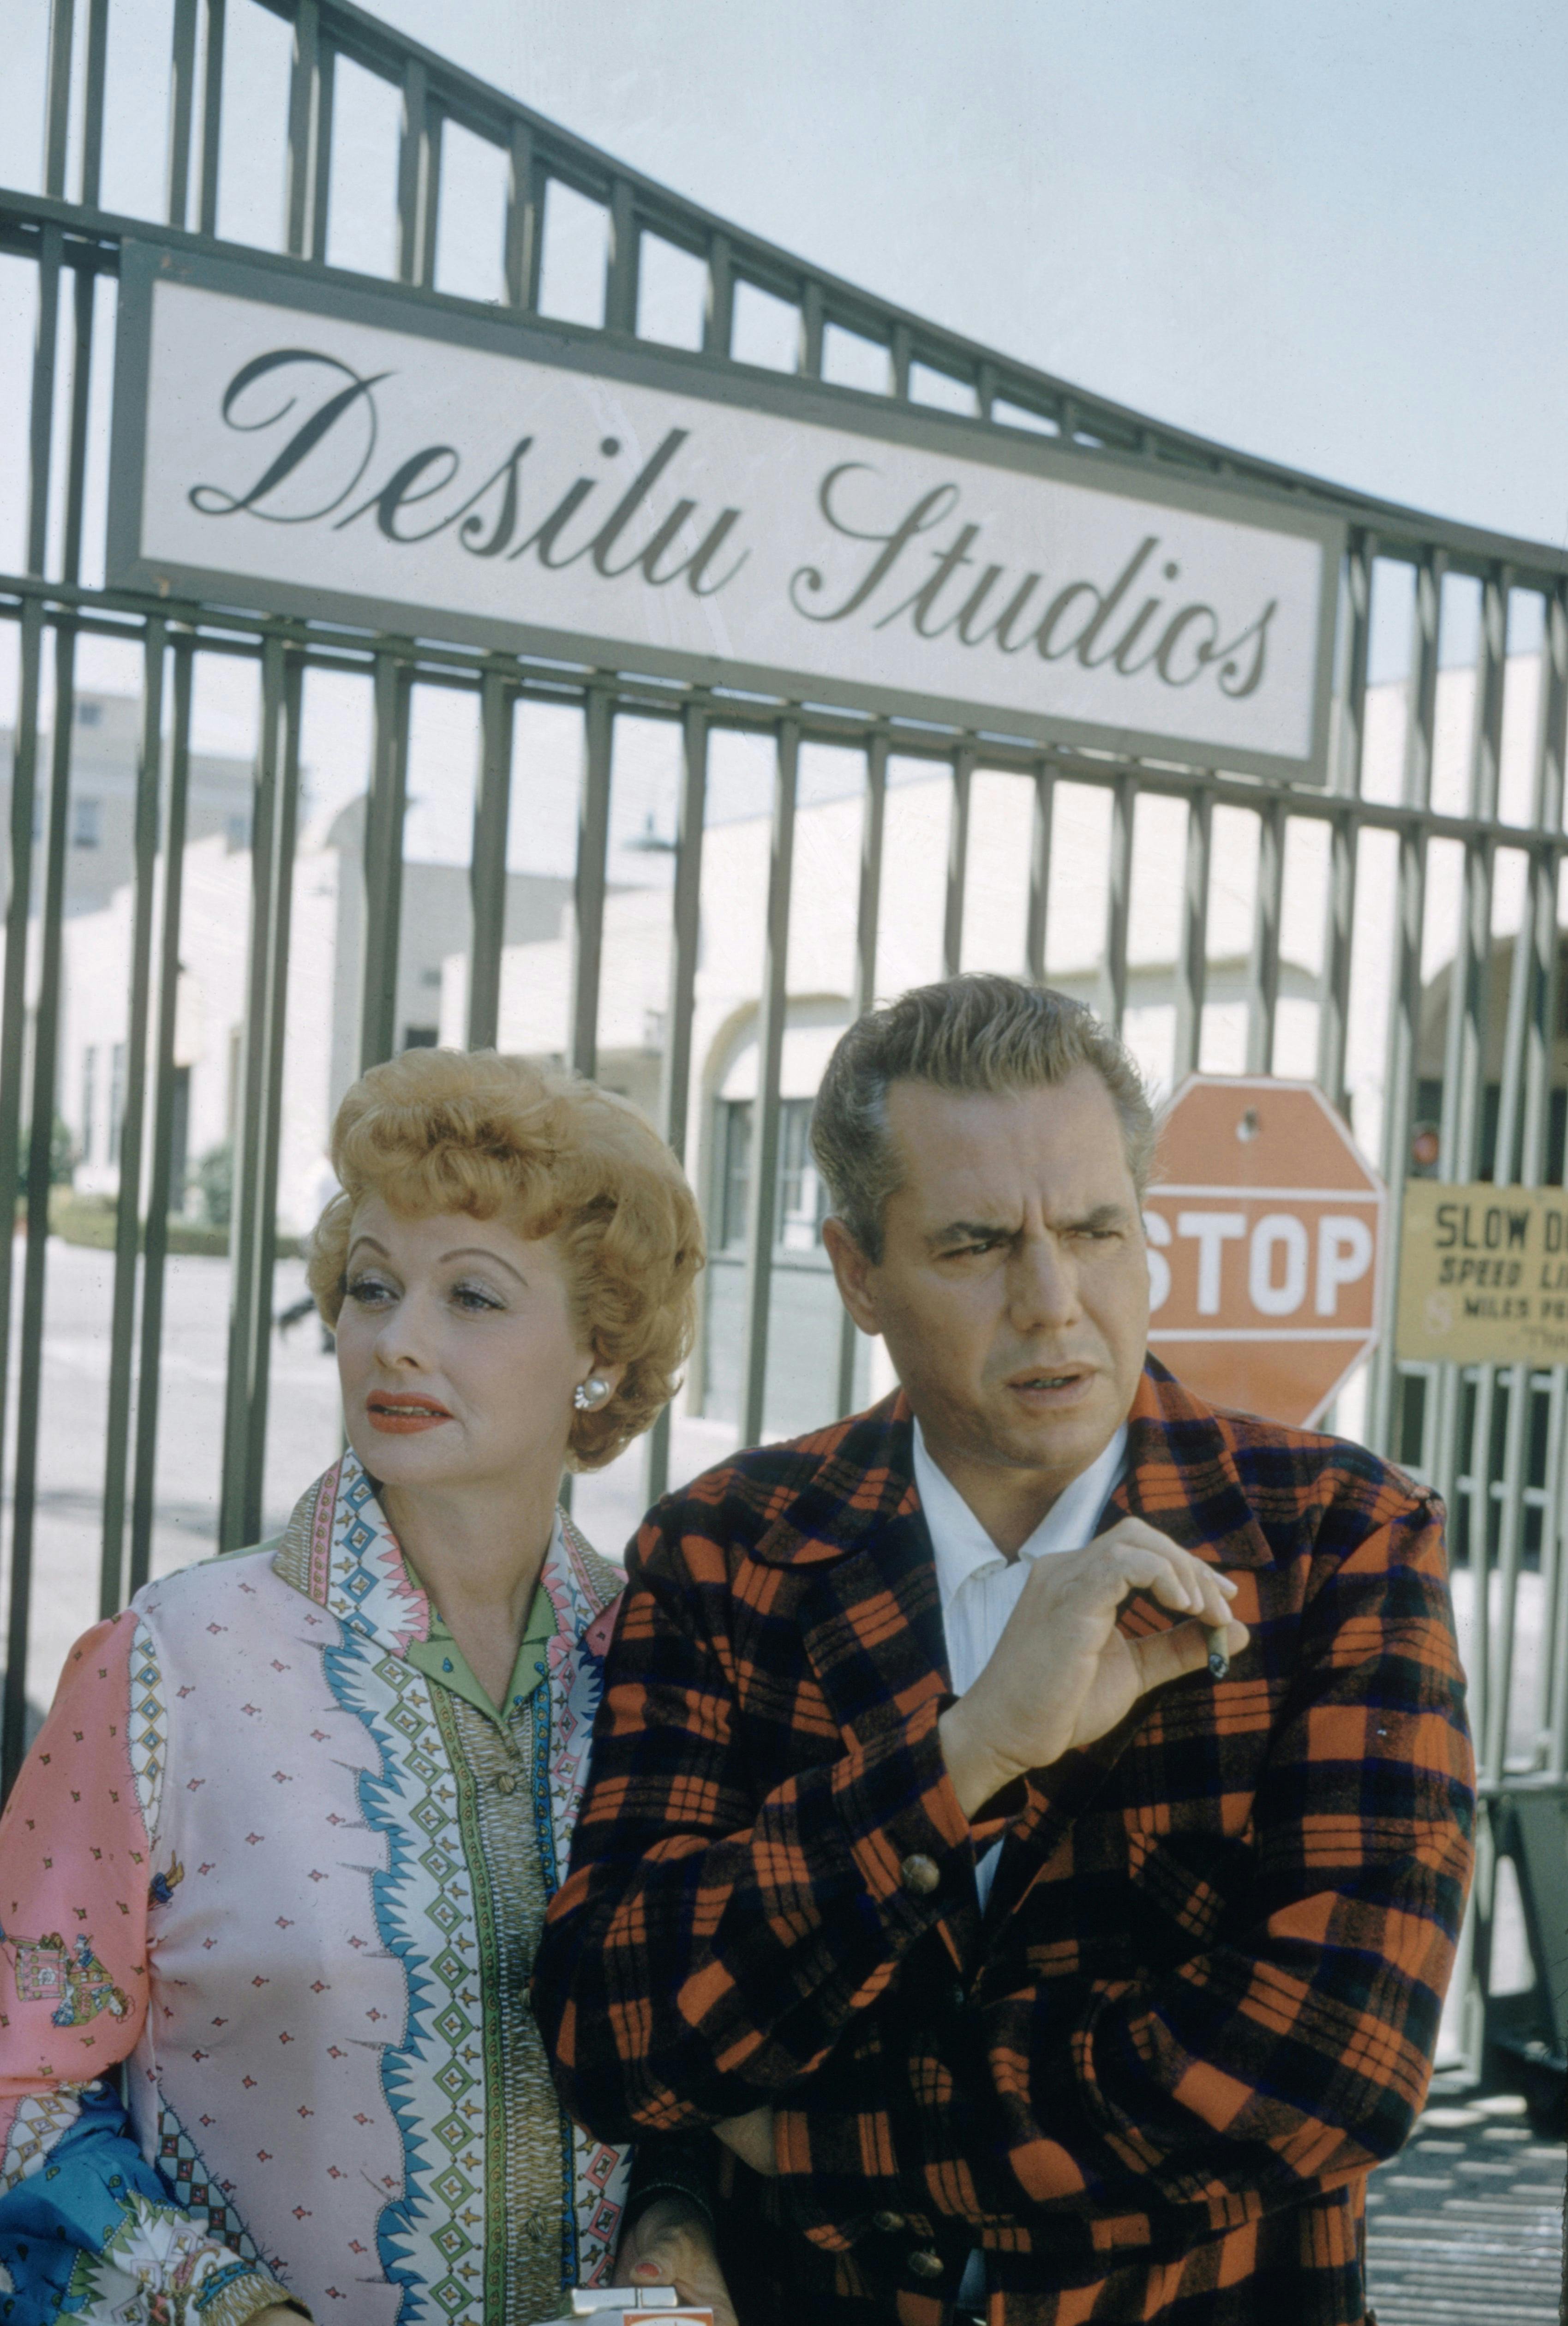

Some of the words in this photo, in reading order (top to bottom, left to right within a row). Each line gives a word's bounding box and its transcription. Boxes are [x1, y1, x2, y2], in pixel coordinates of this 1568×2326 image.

[188, 349, 751, 596] Desilu
[789, 462, 1277, 699] Studios
[1436, 1204, 1530, 1249] SLOW
[1545, 1210, 1568, 1253] D
[1439, 1256, 1522, 1288] SPEED
[1541, 1262, 1568, 1289] LI
